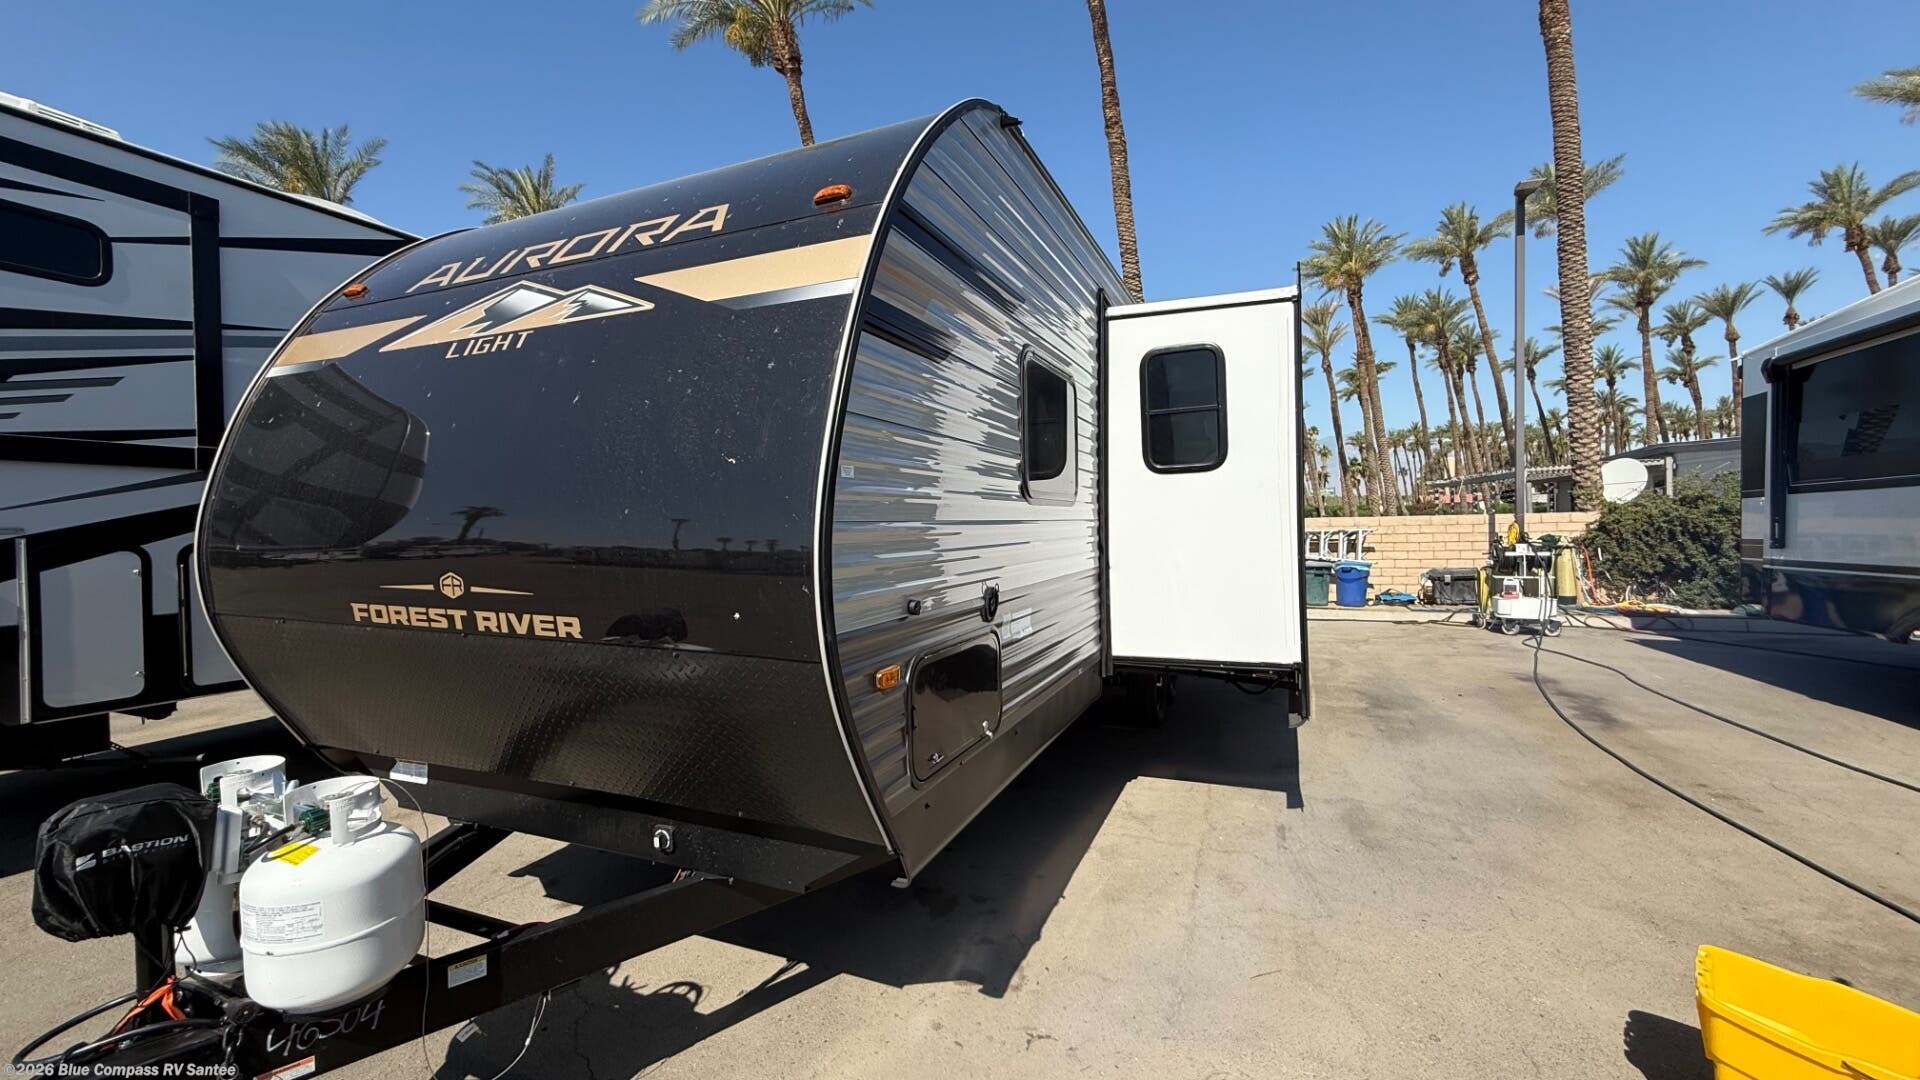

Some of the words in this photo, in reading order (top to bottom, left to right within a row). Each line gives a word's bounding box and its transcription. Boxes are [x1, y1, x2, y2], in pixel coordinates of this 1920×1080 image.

[406, 203, 730, 293] AURORA
[445, 330, 534, 359] LIGHT
[350, 602, 467, 630] FOREST
[474, 610, 583, 639] RIVER
[102, 834, 190, 858] BASTION
